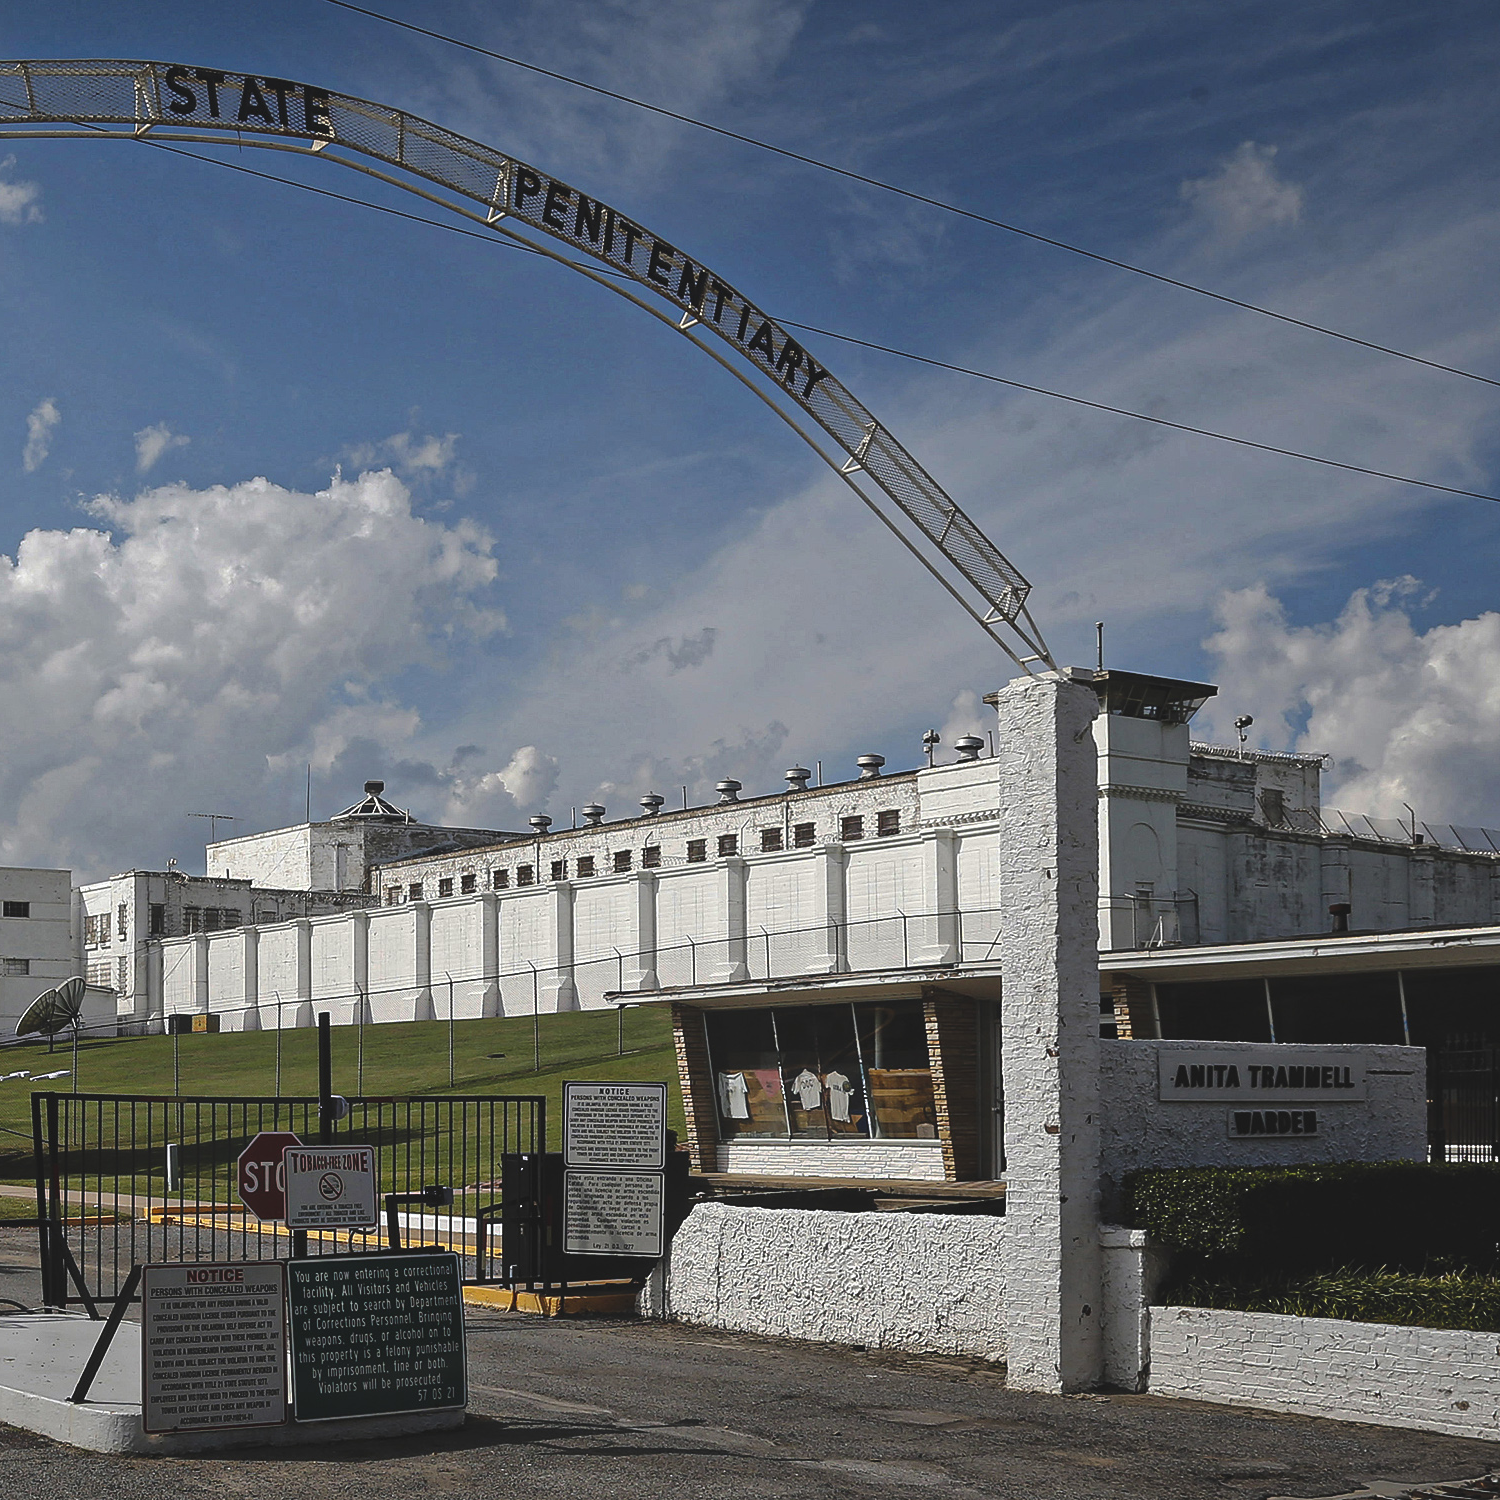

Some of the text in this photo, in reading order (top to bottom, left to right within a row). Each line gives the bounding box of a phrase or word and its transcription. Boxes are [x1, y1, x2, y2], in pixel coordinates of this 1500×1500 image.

[166, 67, 330, 135] STATE
[514, 166, 828, 399] PENITENTIARY
[1174, 1065, 1355, 1088] ANITA TRAMMELL
[1234, 1110, 1318, 1134] WARDEN
[342, 1152, 368, 1172] ZONE
[244, 1162, 284, 1192] STO
[187, 1268, 244, 1283] NOTICE
[295, 1264, 453, 1283] You are now entering a correctional
[150, 1283, 278, 1298] PERSONS WITH CONCEALED WEAPONS
[303, 1280, 448, 1300] facility. All Visitors and Vehicles
[294, 1295, 458, 1316] are subject to search by Department
[303, 1311, 452, 1331] of Corrections Personnel. Bringing
[381, 1331, 390, 1342] or
[395, 1327, 424, 1341] alcohol
[429, 1328, 438, 1338] on
[443, 1326, 451, 1337] to
[299, 1341, 459, 1364] this property is a felony punishable
[312, 1367, 322, 1381] by
[394, 1360, 409, 1372] fine
[415, 1360, 422, 1371] or
[428, 1357, 448, 1370] both.
[319, 1373, 443, 1394] Violators will be prosecuted.
[418, 1387, 455, 1402] 57 OS 21
